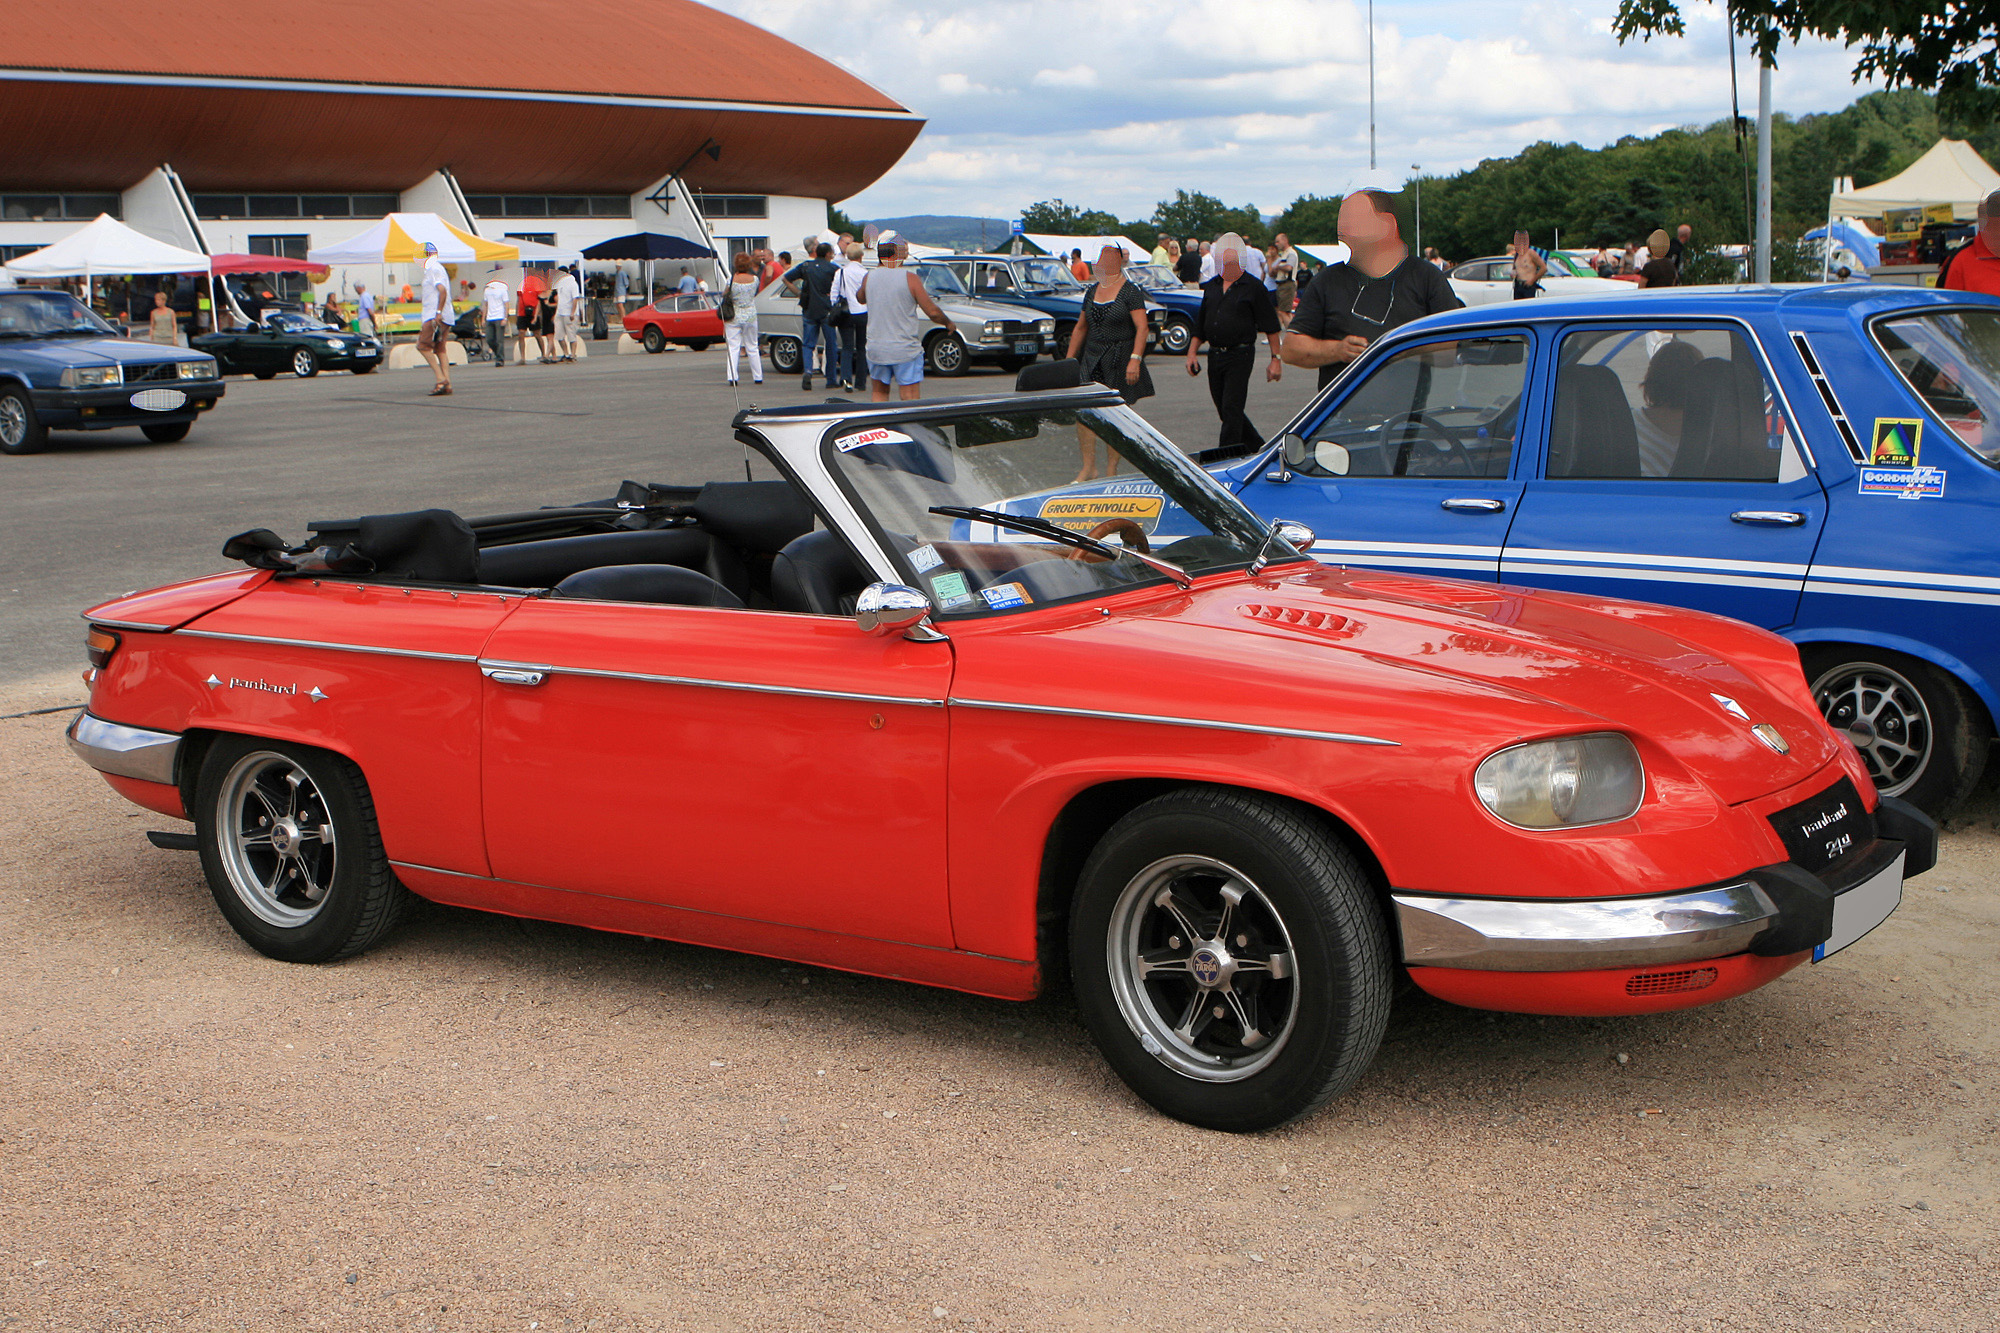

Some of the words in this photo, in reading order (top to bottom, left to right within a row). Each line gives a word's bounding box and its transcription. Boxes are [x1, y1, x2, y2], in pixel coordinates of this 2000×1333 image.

[859, 430, 889, 444] AUTO
[1047, 503, 1087, 514] GROUPE
[1088, 502, 1136, 513] THIVOLLE
[229, 677, 297, 695] panhard
[1802, 803, 1848, 838] panhard
